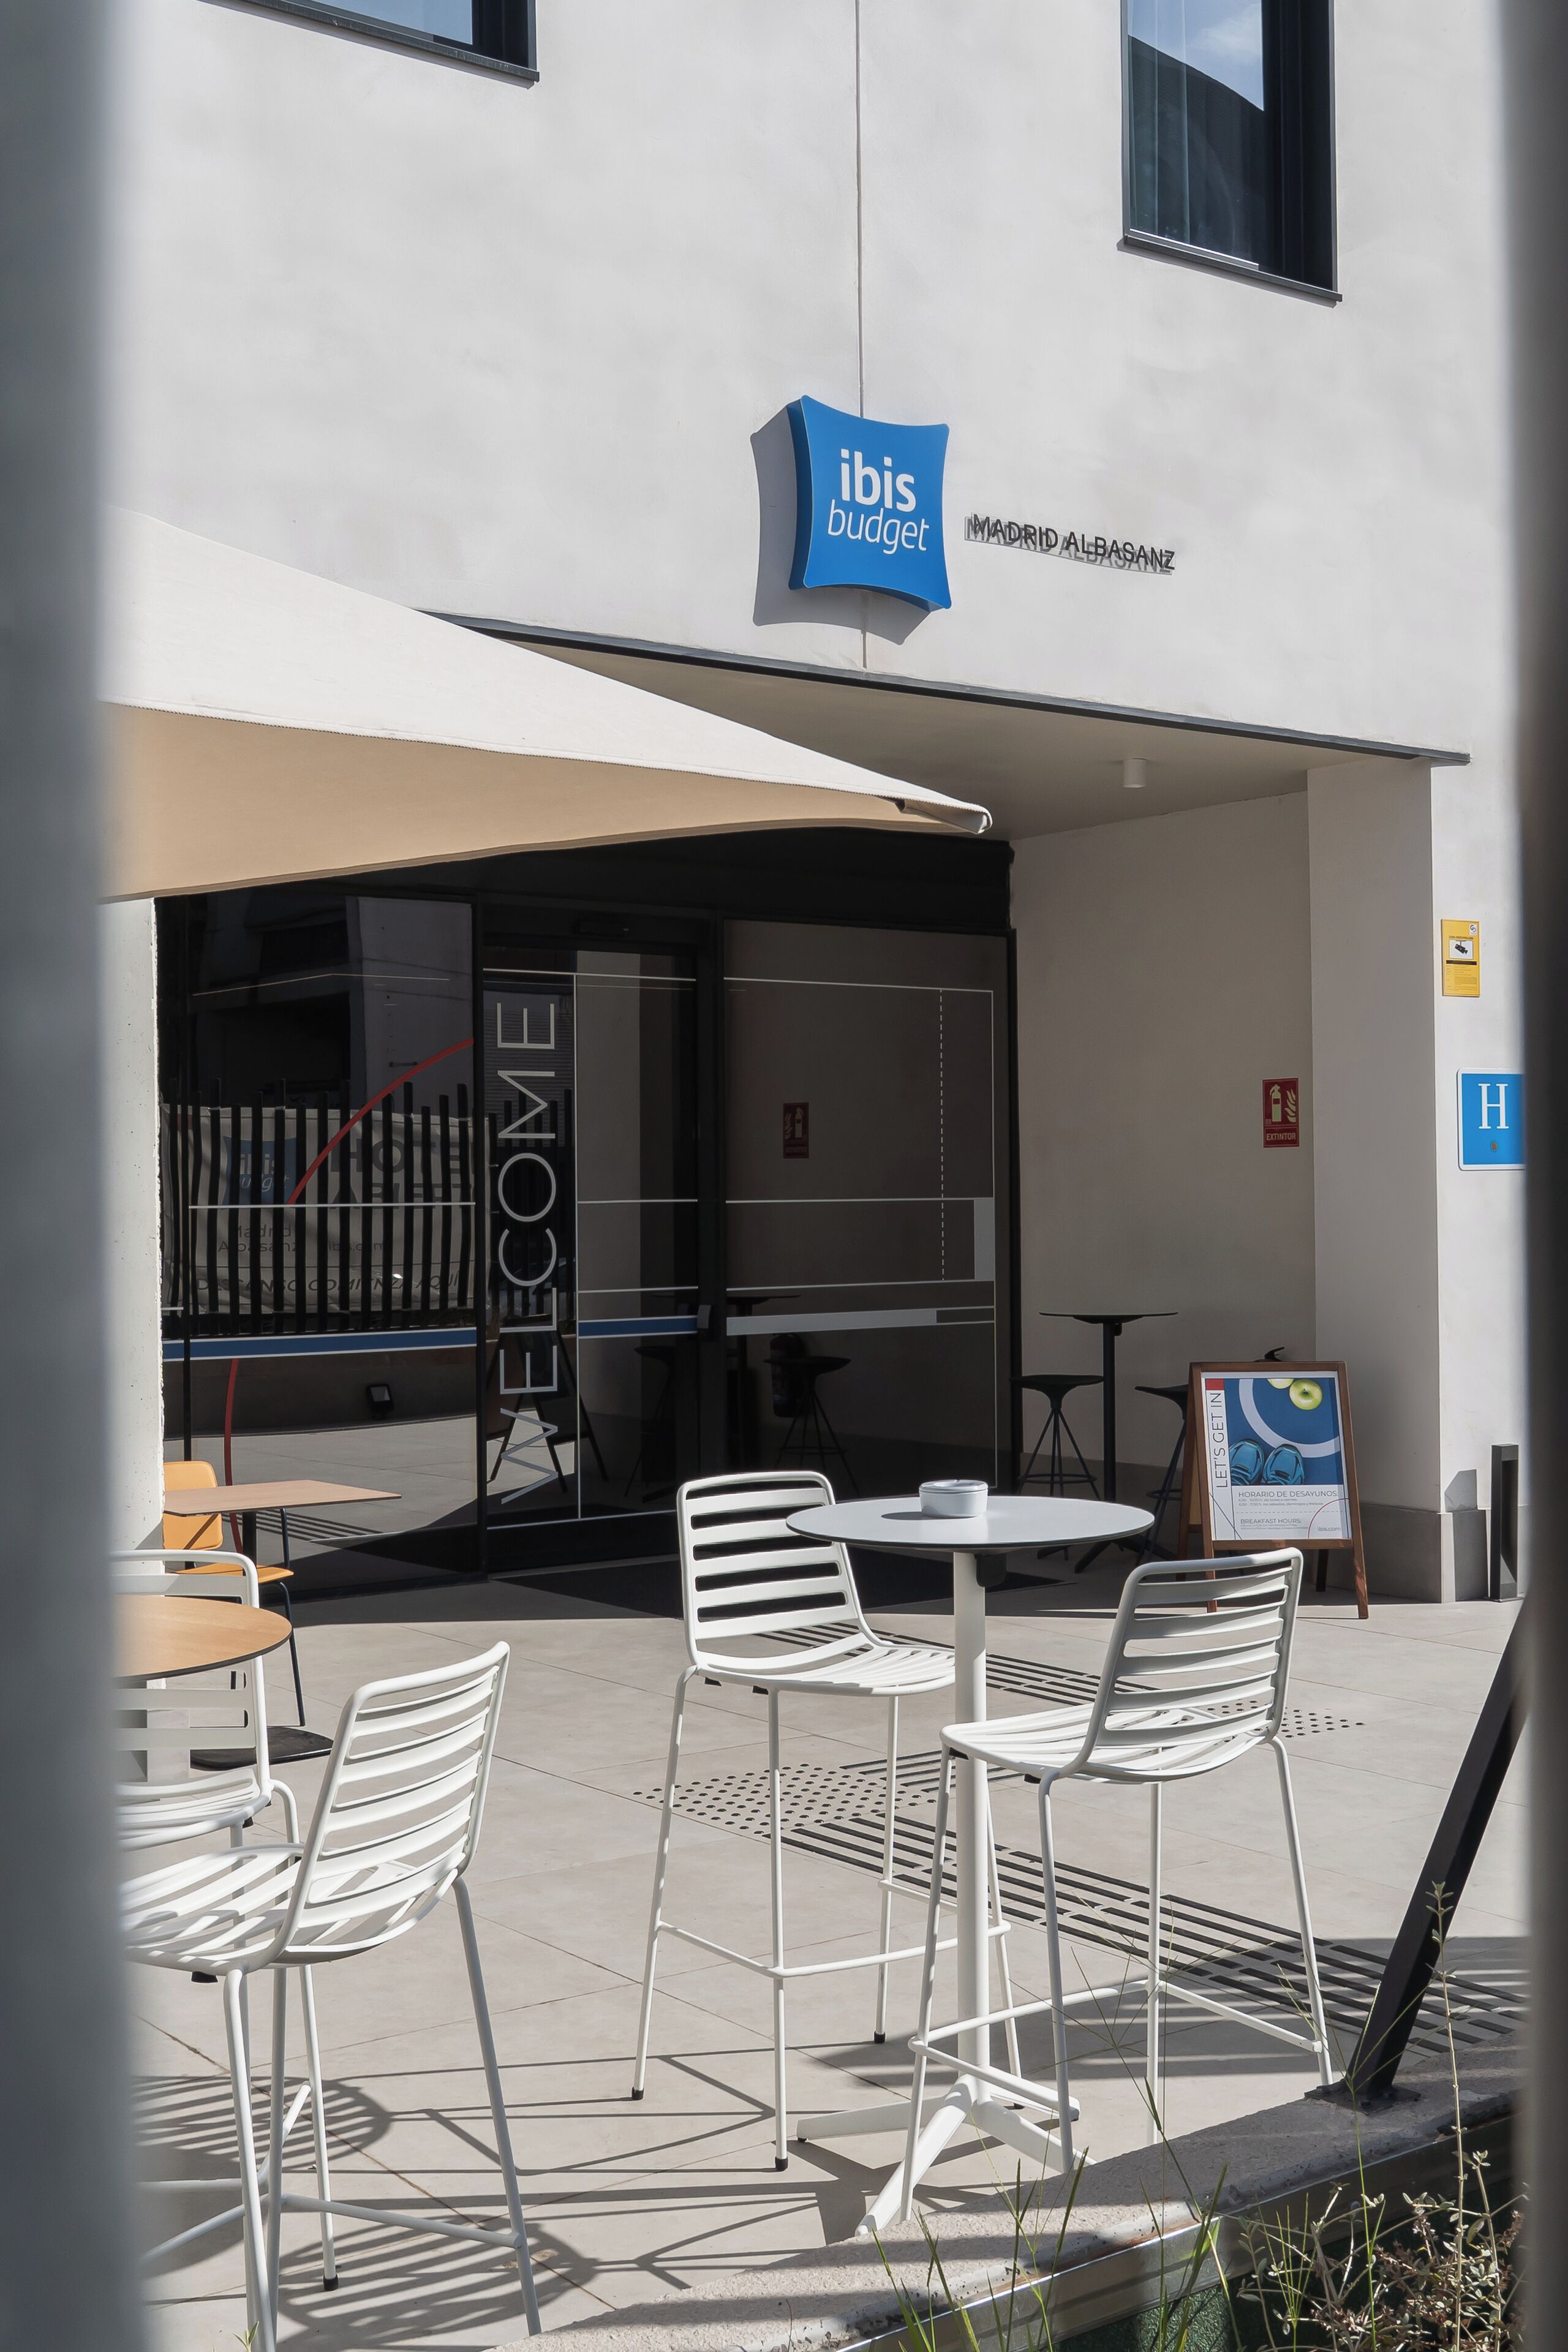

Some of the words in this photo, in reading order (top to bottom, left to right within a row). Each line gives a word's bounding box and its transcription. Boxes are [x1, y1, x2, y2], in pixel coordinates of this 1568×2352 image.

[840, 448, 916, 512] ibis
[827, 499, 930, 555] budget
[973, 513, 1058, 549] MADRID
[1065, 531, 1175, 571] ALBASANZ
[1478, 1083, 1509, 1129] H
[496, 1002, 559, 1505] WELCOME
[1210, 1392, 1223, 1408] IN
[1211, 1412, 1224, 1443] GET
